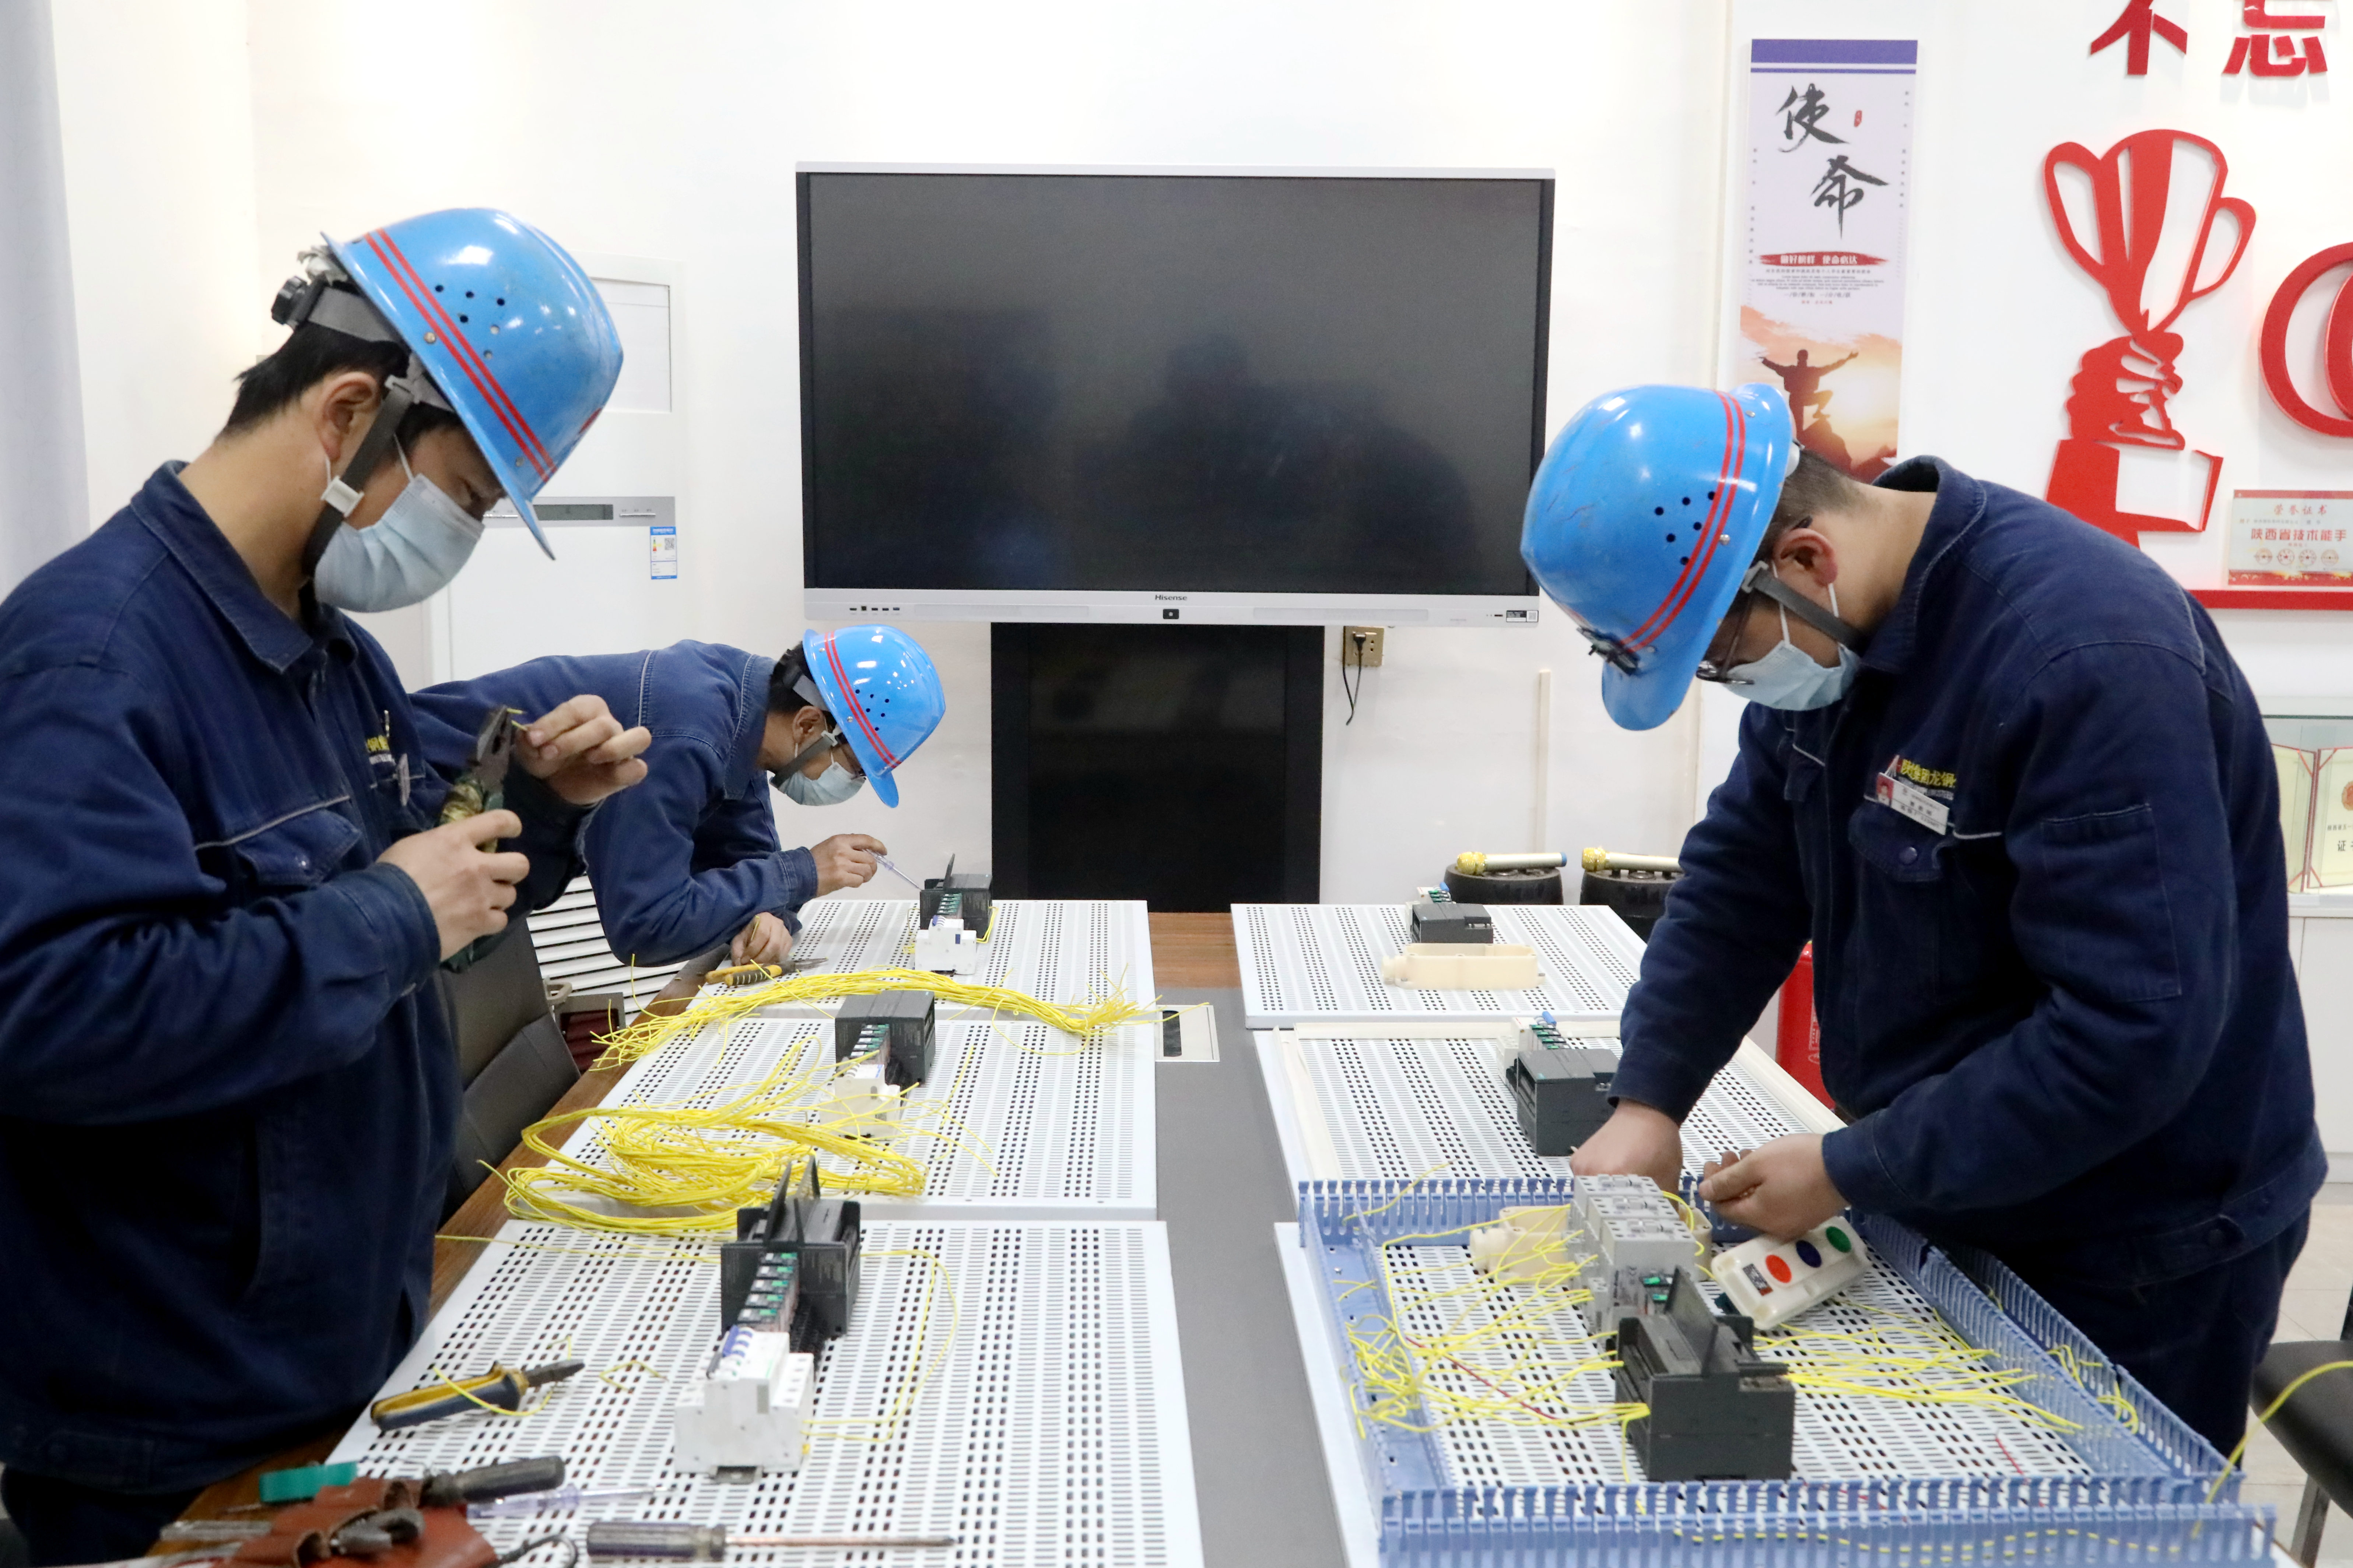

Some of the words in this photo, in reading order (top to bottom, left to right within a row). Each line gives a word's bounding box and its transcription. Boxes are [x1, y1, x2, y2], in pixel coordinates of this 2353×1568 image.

[1775, 83, 1889, 239] 使命
[2251, 527, 2347, 542] 陕西省技术能手
